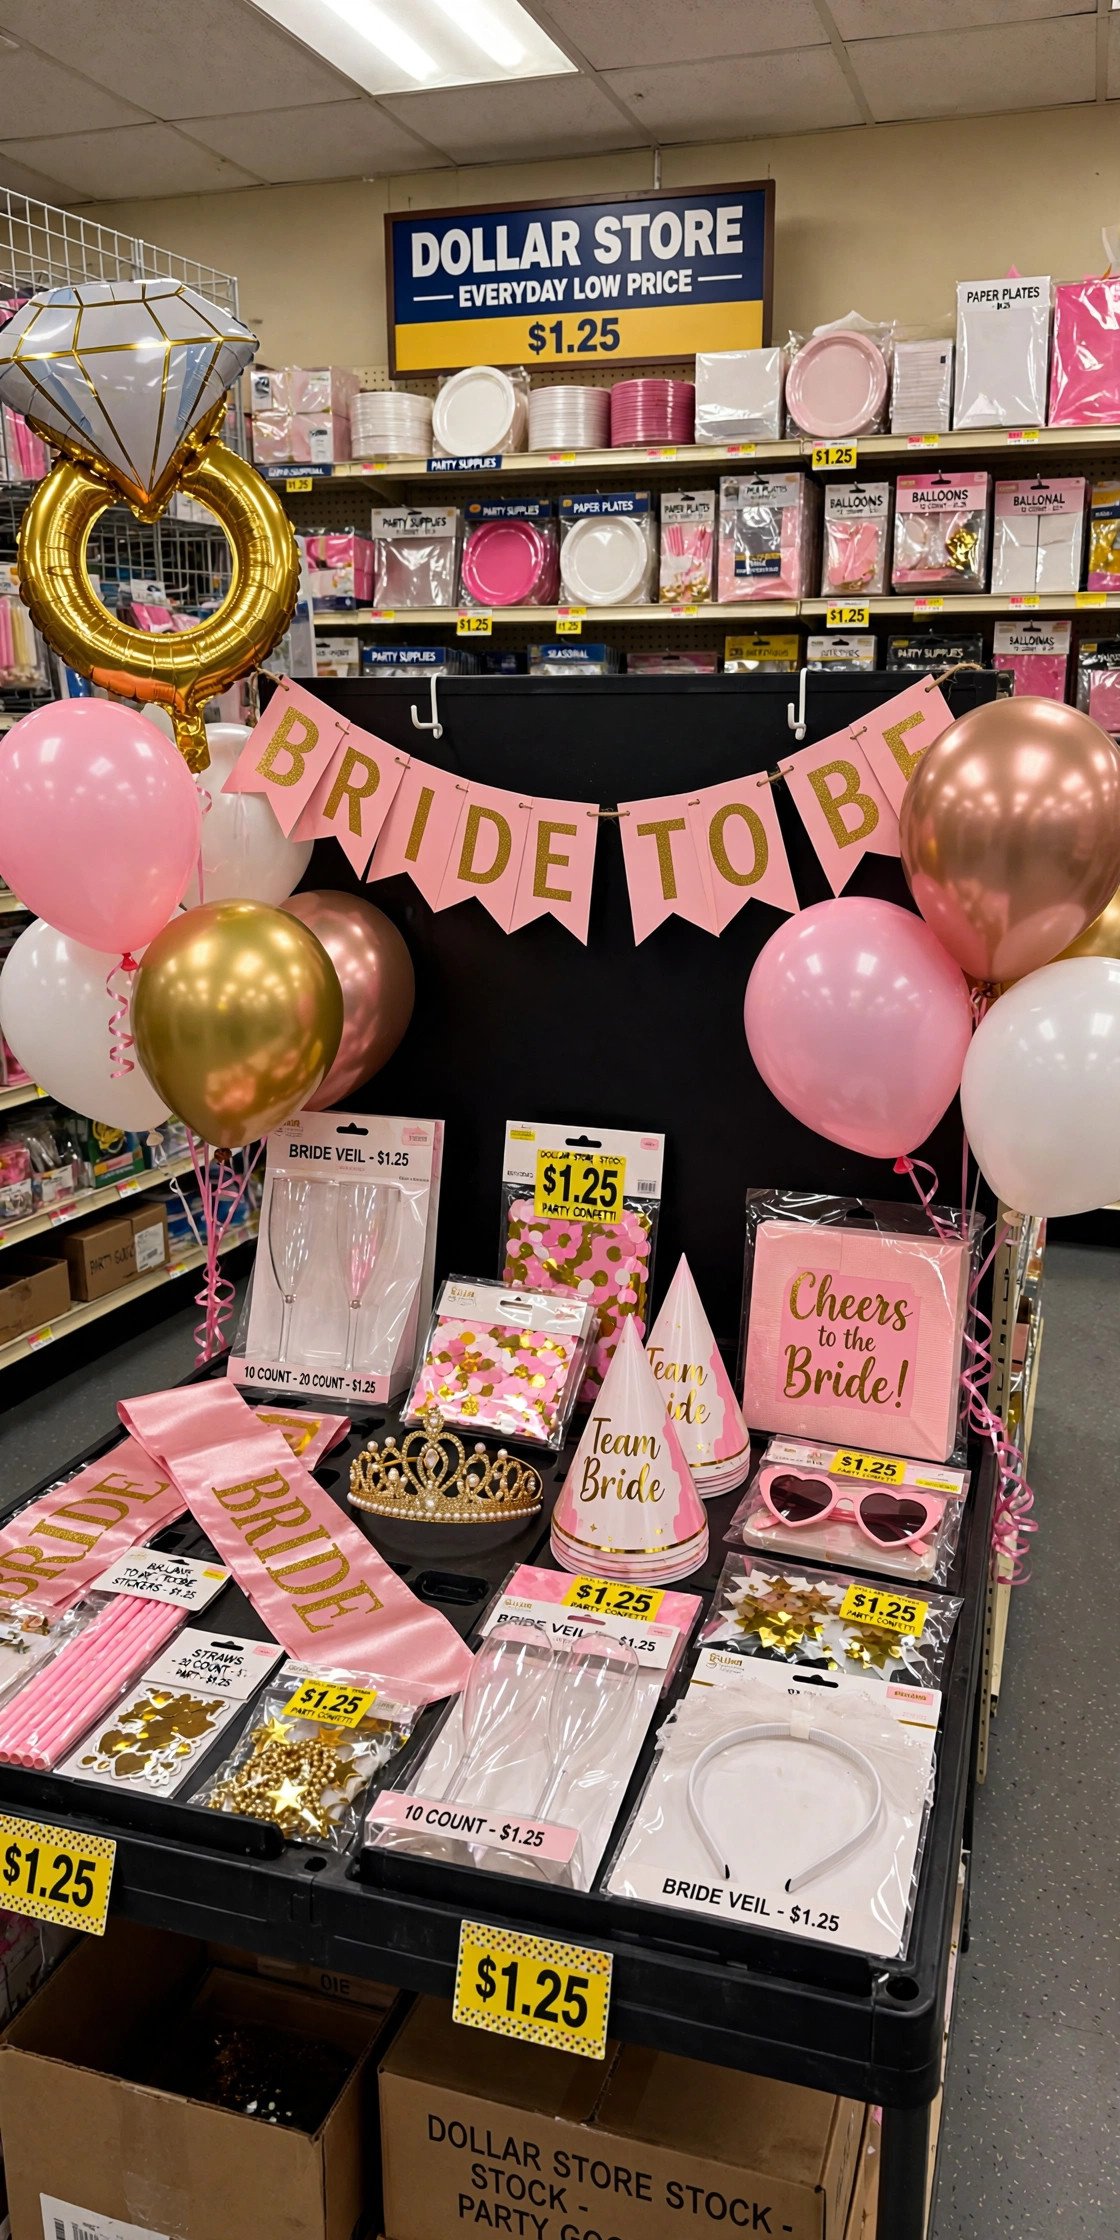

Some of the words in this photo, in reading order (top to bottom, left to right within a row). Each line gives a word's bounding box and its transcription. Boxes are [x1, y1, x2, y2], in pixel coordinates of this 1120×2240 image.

[411, 219, 581, 278] DOLLAR
[593, 205, 744, 265] STORE
[459, 278, 569, 308] EVERYDAY
[573, 274, 621, 300] LOW
[627, 269, 693, 297] PRICE
[966, 288, 999, 303] PAPER
[1002, 286, 1041, 300] PLATES
[528, 317, 621, 356] $1.25
[431, 459, 457, 471] PARTY
[458, 456, 497, 470] SUPPLIES
[815, 448, 853, 465] $1.25
[573, 502, 600, 514] PAPER
[602, 500, 634, 513] PLATES
[829, 494, 884, 509] BALLOONS
[911, 489, 969, 503] BALLOONS
[1013, 492, 1066, 507] BALLONAL
[459, 618, 489, 632] $1.25
[829, 607, 865, 623] $1.25
[371, 652, 398, 663] PARTY
[399, 651, 436, 663] SUPPLIES
[254, 706, 577, 902] BRIDE
[636, 803, 769, 900] TO
[289, 1143, 332, 1161] BRIDE
[335, 1147, 366, 1163] VEIL
[377, 1150, 409, 1167] $1.25
[542, 1163, 618, 1208] $1.25
[789, 1271, 914, 1332] Cheers
[818, 1325, 837, 1347] to
[843, 1326, 876, 1352] the
[243, 1366, 257, 1378] 10
[257, 1367, 291, 1384] COUNT
[299, 1372, 311, 1386] 20
[312, 1374, 345, 1391] COUNT
[351, 1378, 376, 1394] $1.25
[646, 1347, 709, 1387] Team
[783, 1344, 910, 1409] Bride!
[666, 1387, 711, 1425] ide
[592, 1416, 662, 1460] Team
[579, 1455, 666, 1504] Bride
[840, 1456, 898, 1477] $1.25
[0, 1472, 171, 1601] BRIDE
[211, 1468, 385, 1634] BRIDE
[576, 1584, 654, 1614] $1.25
[852, 1593, 917, 1623] $1.25
[191, 1648, 244, 1666] STRAWS
[619, 1635, 656, 1652] $1.25
[300, 1687, 364, 1715] $1.25
[404, 1804, 424, 1821] 10
[425, 1808, 487, 1835] COUNT
[499, 1823, 546, 1848] $1.25
[2, 1842, 97, 1908] $1.25
[661, 1877, 723, 1905] BRIDE
[728, 1891, 771, 1916] VEIL
[789, 1904, 840, 1932] $1.25
[475, 1955, 590, 2029] $1.25
[428, 2113, 541, 2172] DOLLAR
[553, 2150, 653, 2202] STORE
[665, 2180, 773, 2234] STOCK
[470, 2162, 568, 2215] STOCK
[458, 2193, 549, 2240] PARTY
